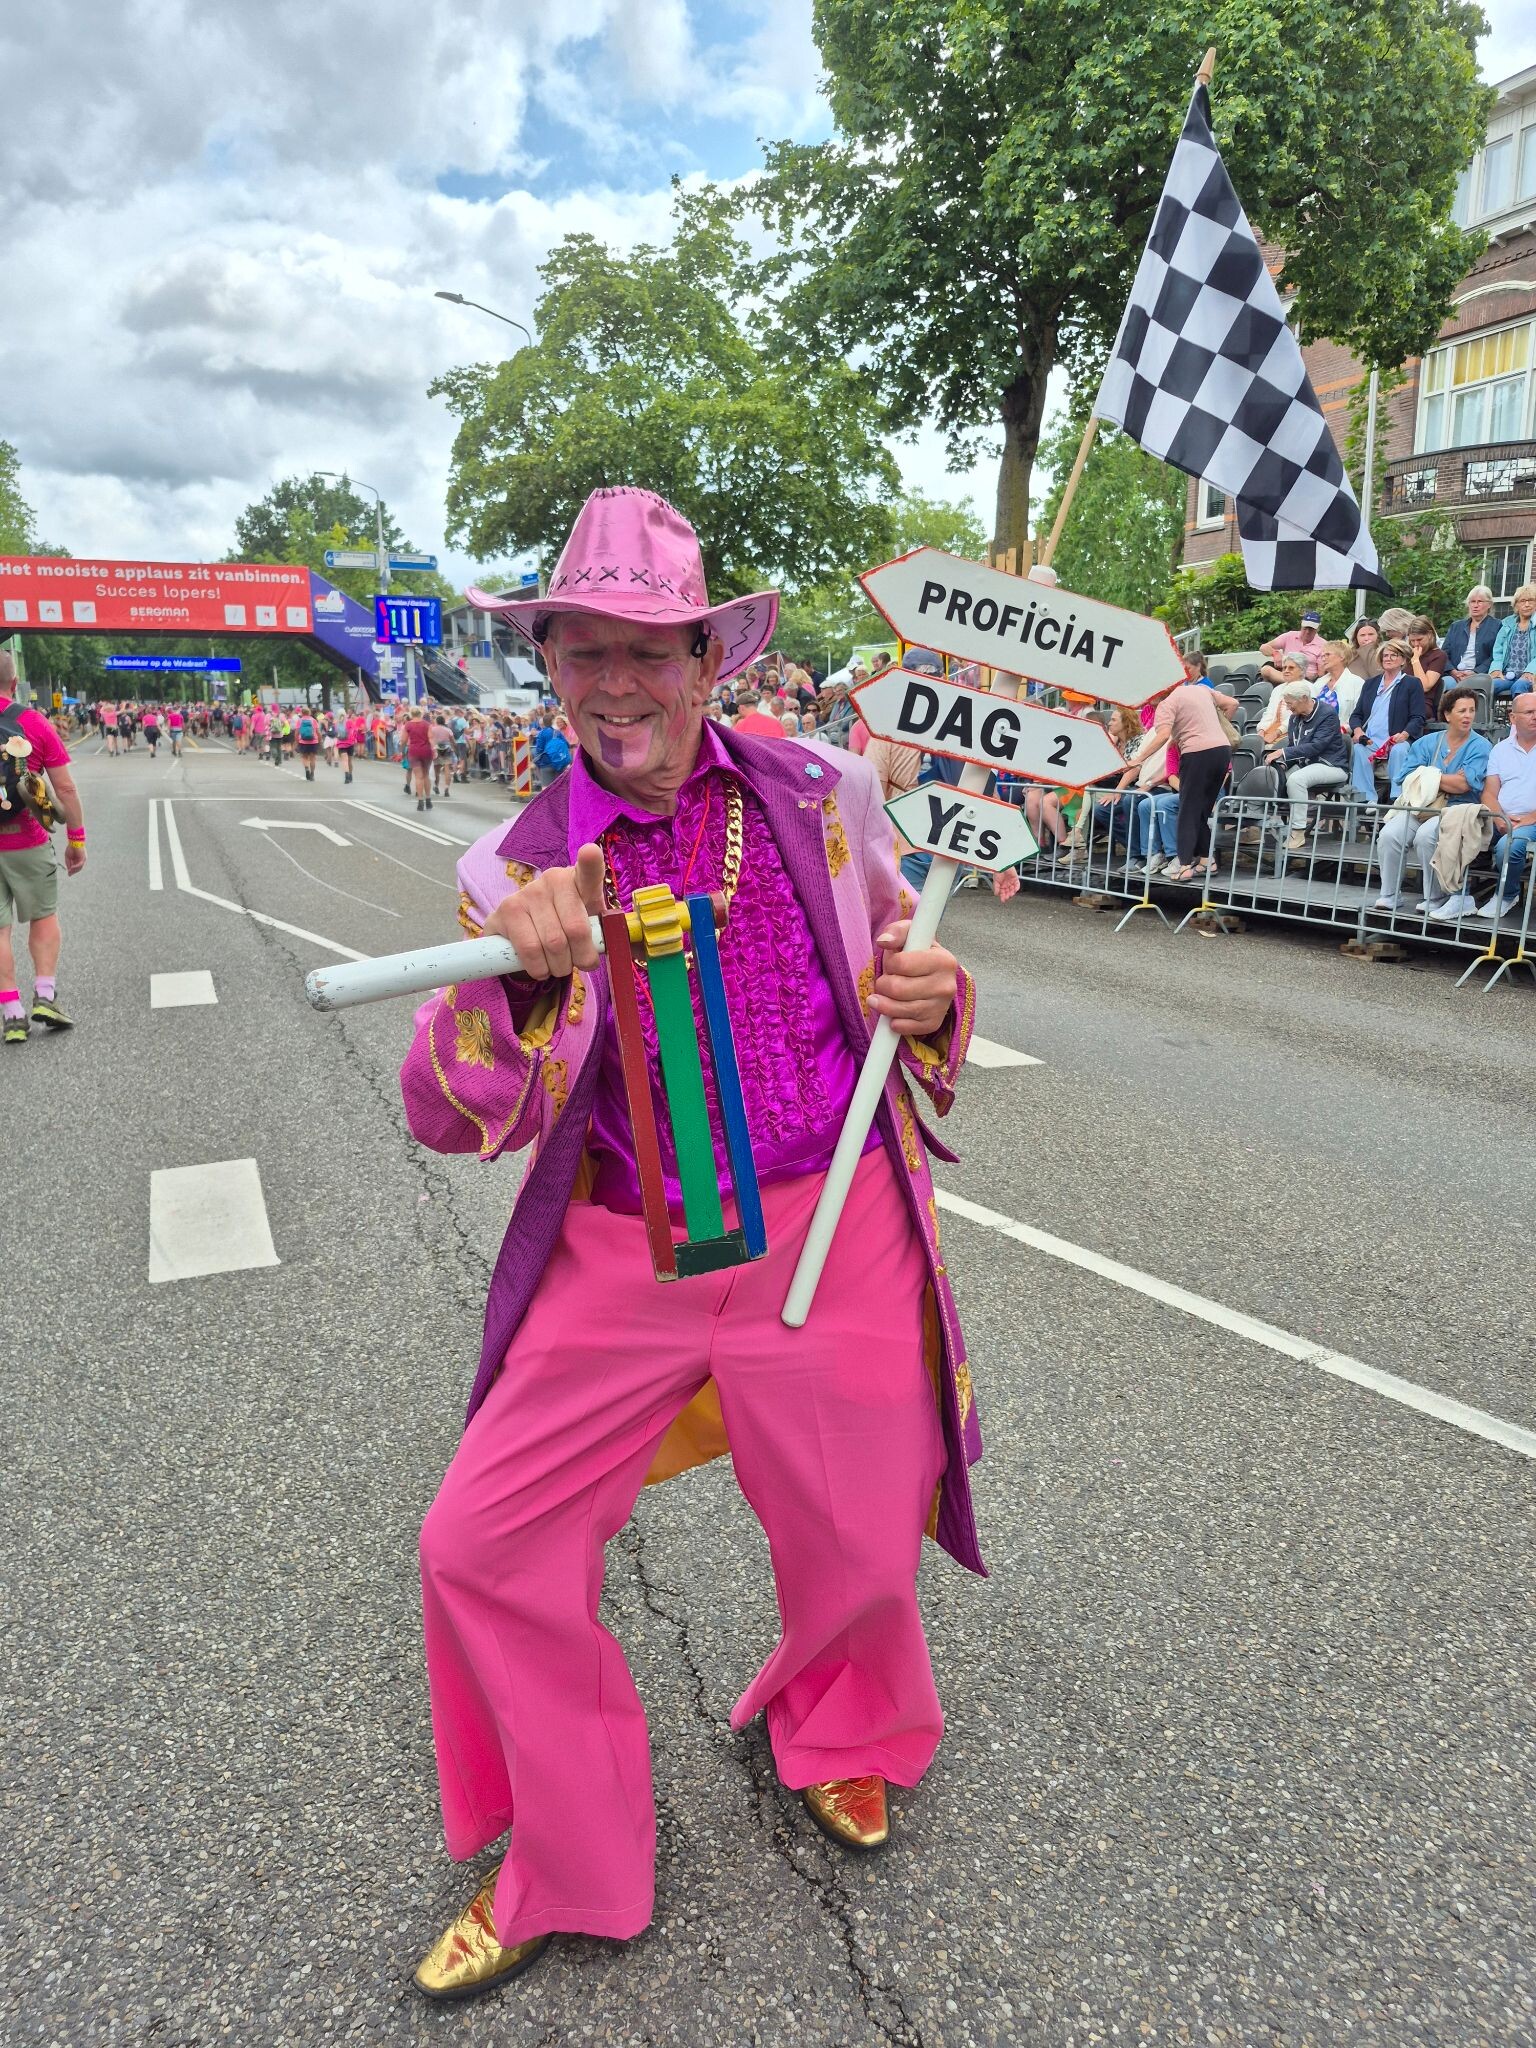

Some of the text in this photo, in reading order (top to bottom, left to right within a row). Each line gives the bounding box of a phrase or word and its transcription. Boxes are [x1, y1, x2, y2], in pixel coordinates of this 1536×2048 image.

[0, 563, 305, 585] Het mooiste applaus zit vanbinnen.
[95, 584, 221, 601] Succes lopers!
[897, 681, 1073, 768] DAG 2
